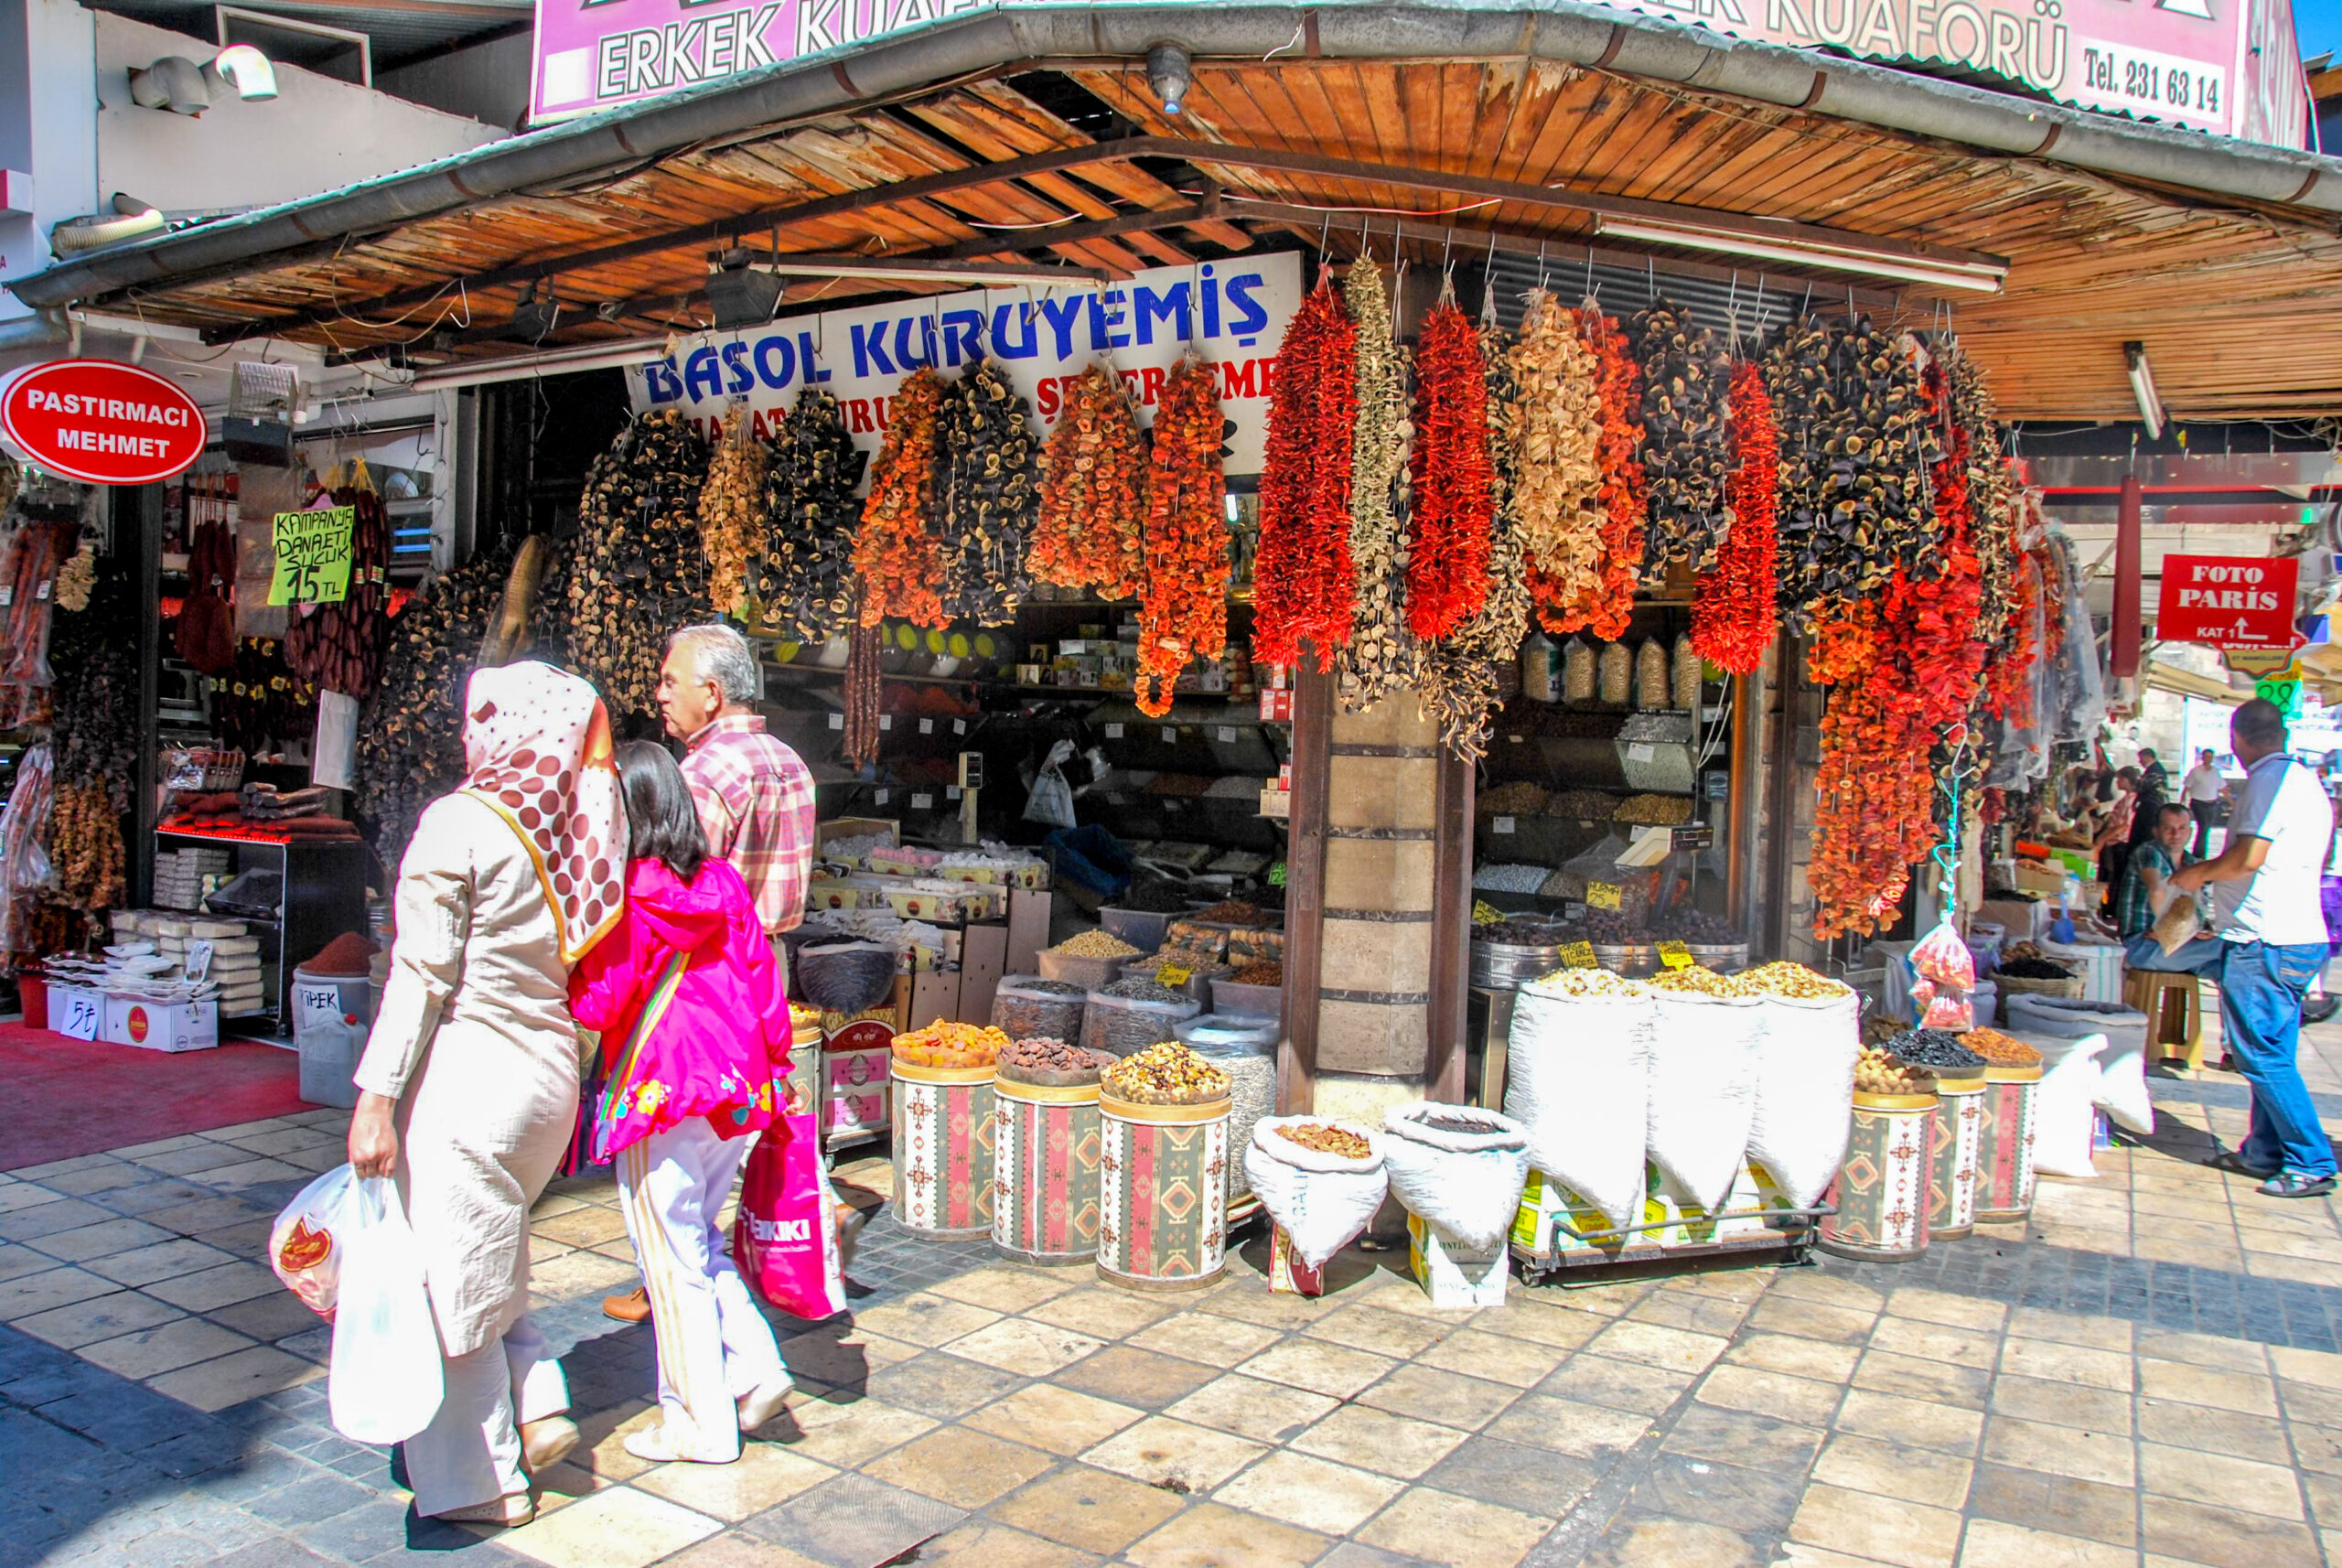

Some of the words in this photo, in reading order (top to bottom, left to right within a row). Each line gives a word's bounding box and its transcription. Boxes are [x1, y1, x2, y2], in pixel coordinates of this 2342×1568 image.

[596, 3, 783, 99] ERKEK
[2084, 48, 2118, 92] Tel.
[2125, 59, 2159, 101] 231
[2166, 69, 2189, 107] 63
[2197, 76, 2218, 113] 14
[643, 331, 832, 404] BAŞOL
[850, 263, 1268, 378] KURUYEMİŞ
[27, 389, 188, 427] PASTIRMACI
[57, 428, 170, 458] MEHMET
[276, 509, 353, 536] KAMPANYA
[284, 546, 349, 572] SUCUK
[285, 566, 321, 605] 15
[322, 582, 341, 596] TL
[2192, 565, 2264, 584] FOTO
[2177, 586, 2279, 611] PARİS
[2197, 628, 2225, 638] KAT
[2229, 628, 2235, 639] 1
